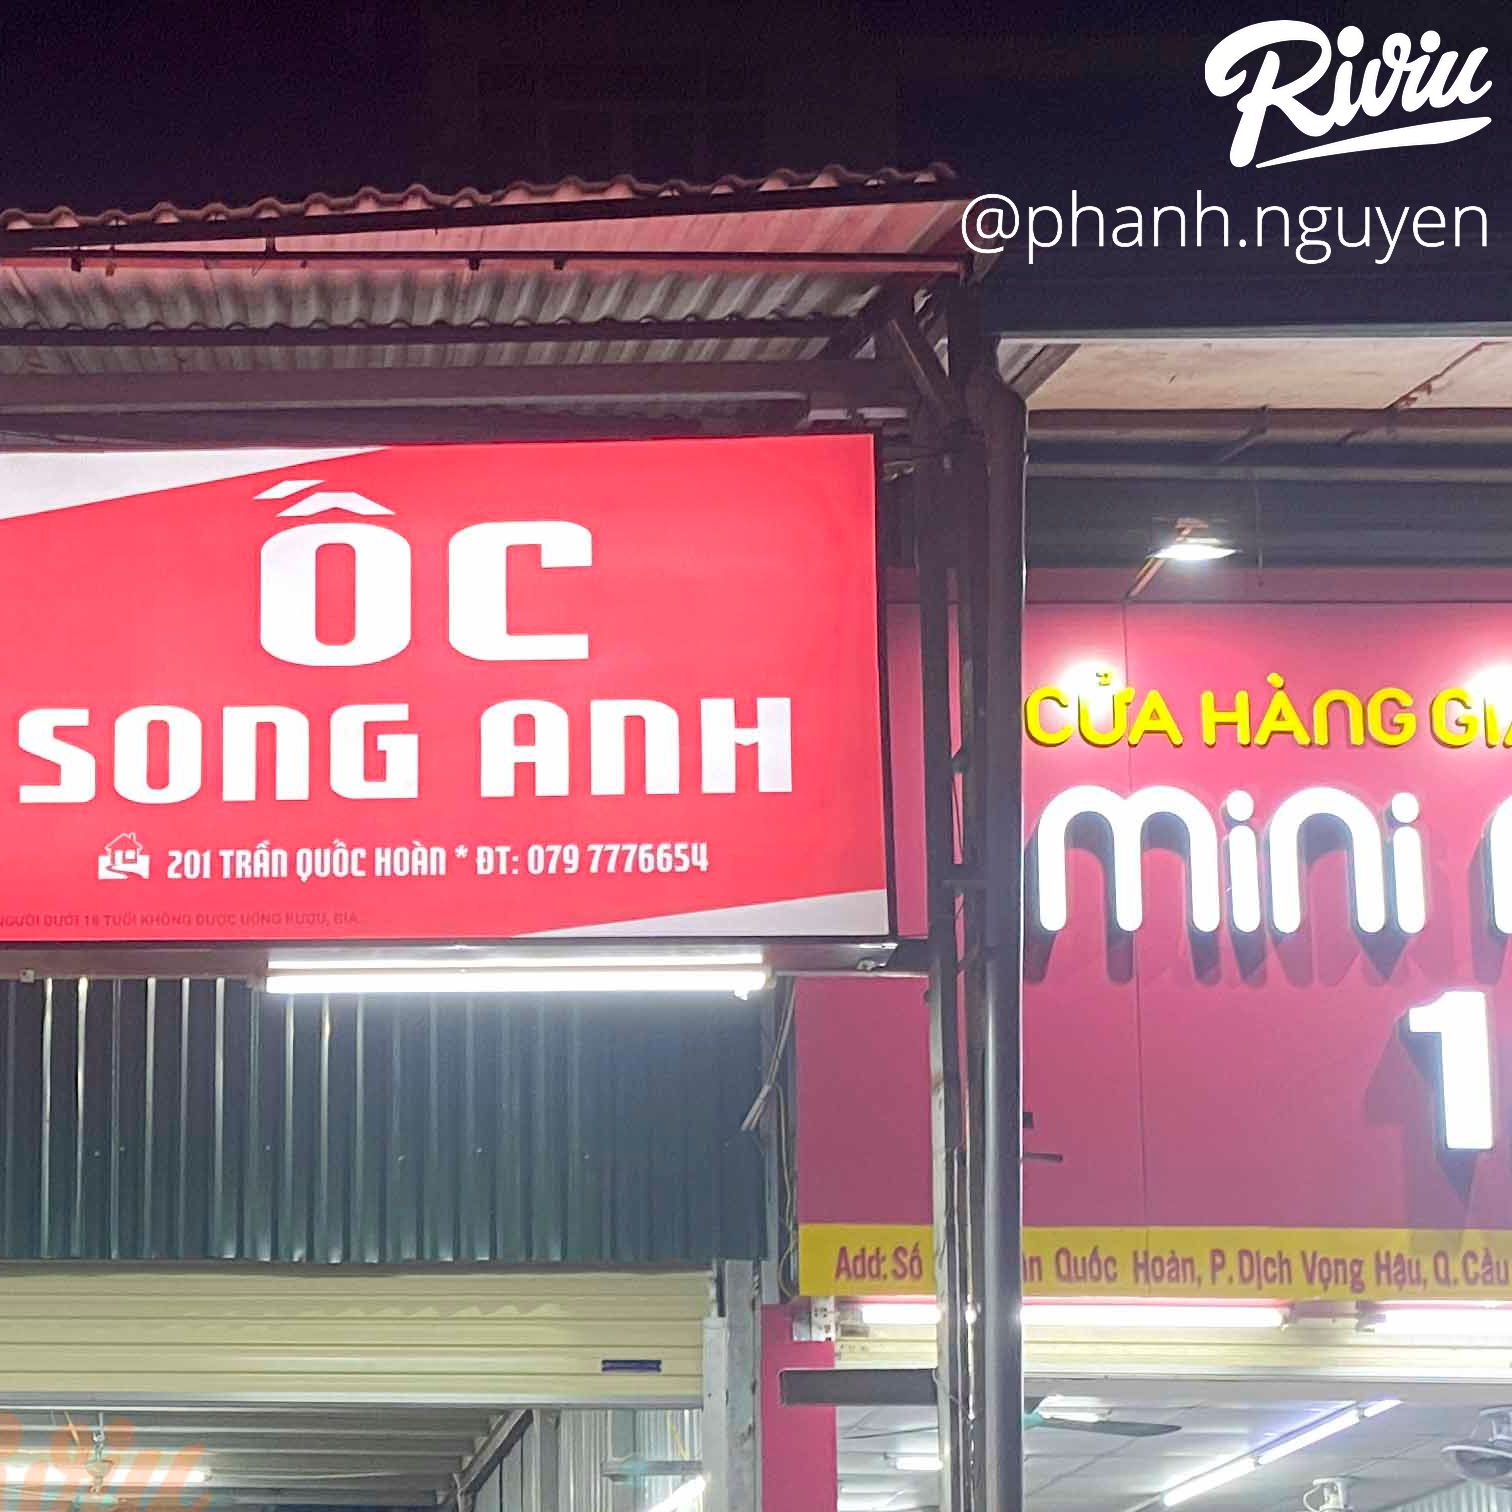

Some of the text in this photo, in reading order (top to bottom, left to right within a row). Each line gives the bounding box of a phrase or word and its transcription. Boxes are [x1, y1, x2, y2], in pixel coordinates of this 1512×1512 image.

[1024, 670, 1512, 748] CỬA HÀNG GI
[18, 696, 793, 805] SONG ANH
[167, 850, 211, 879] 201
[374, 840, 446, 877] HOÀN
[476, 845, 519, 875] ĐT:
[527, 844, 579, 875] 079
[587, 841, 709, 874] 7776654
[1036, 785, 1426, 933] mini
[1055, 1246, 1117, 1283] Quốc
[1133, 1249, 1201, 1288] Hoàn,
[1301, 1250, 1365, 1293] Vọng
[1375, 1249, 1427, 1291] Hậu,
